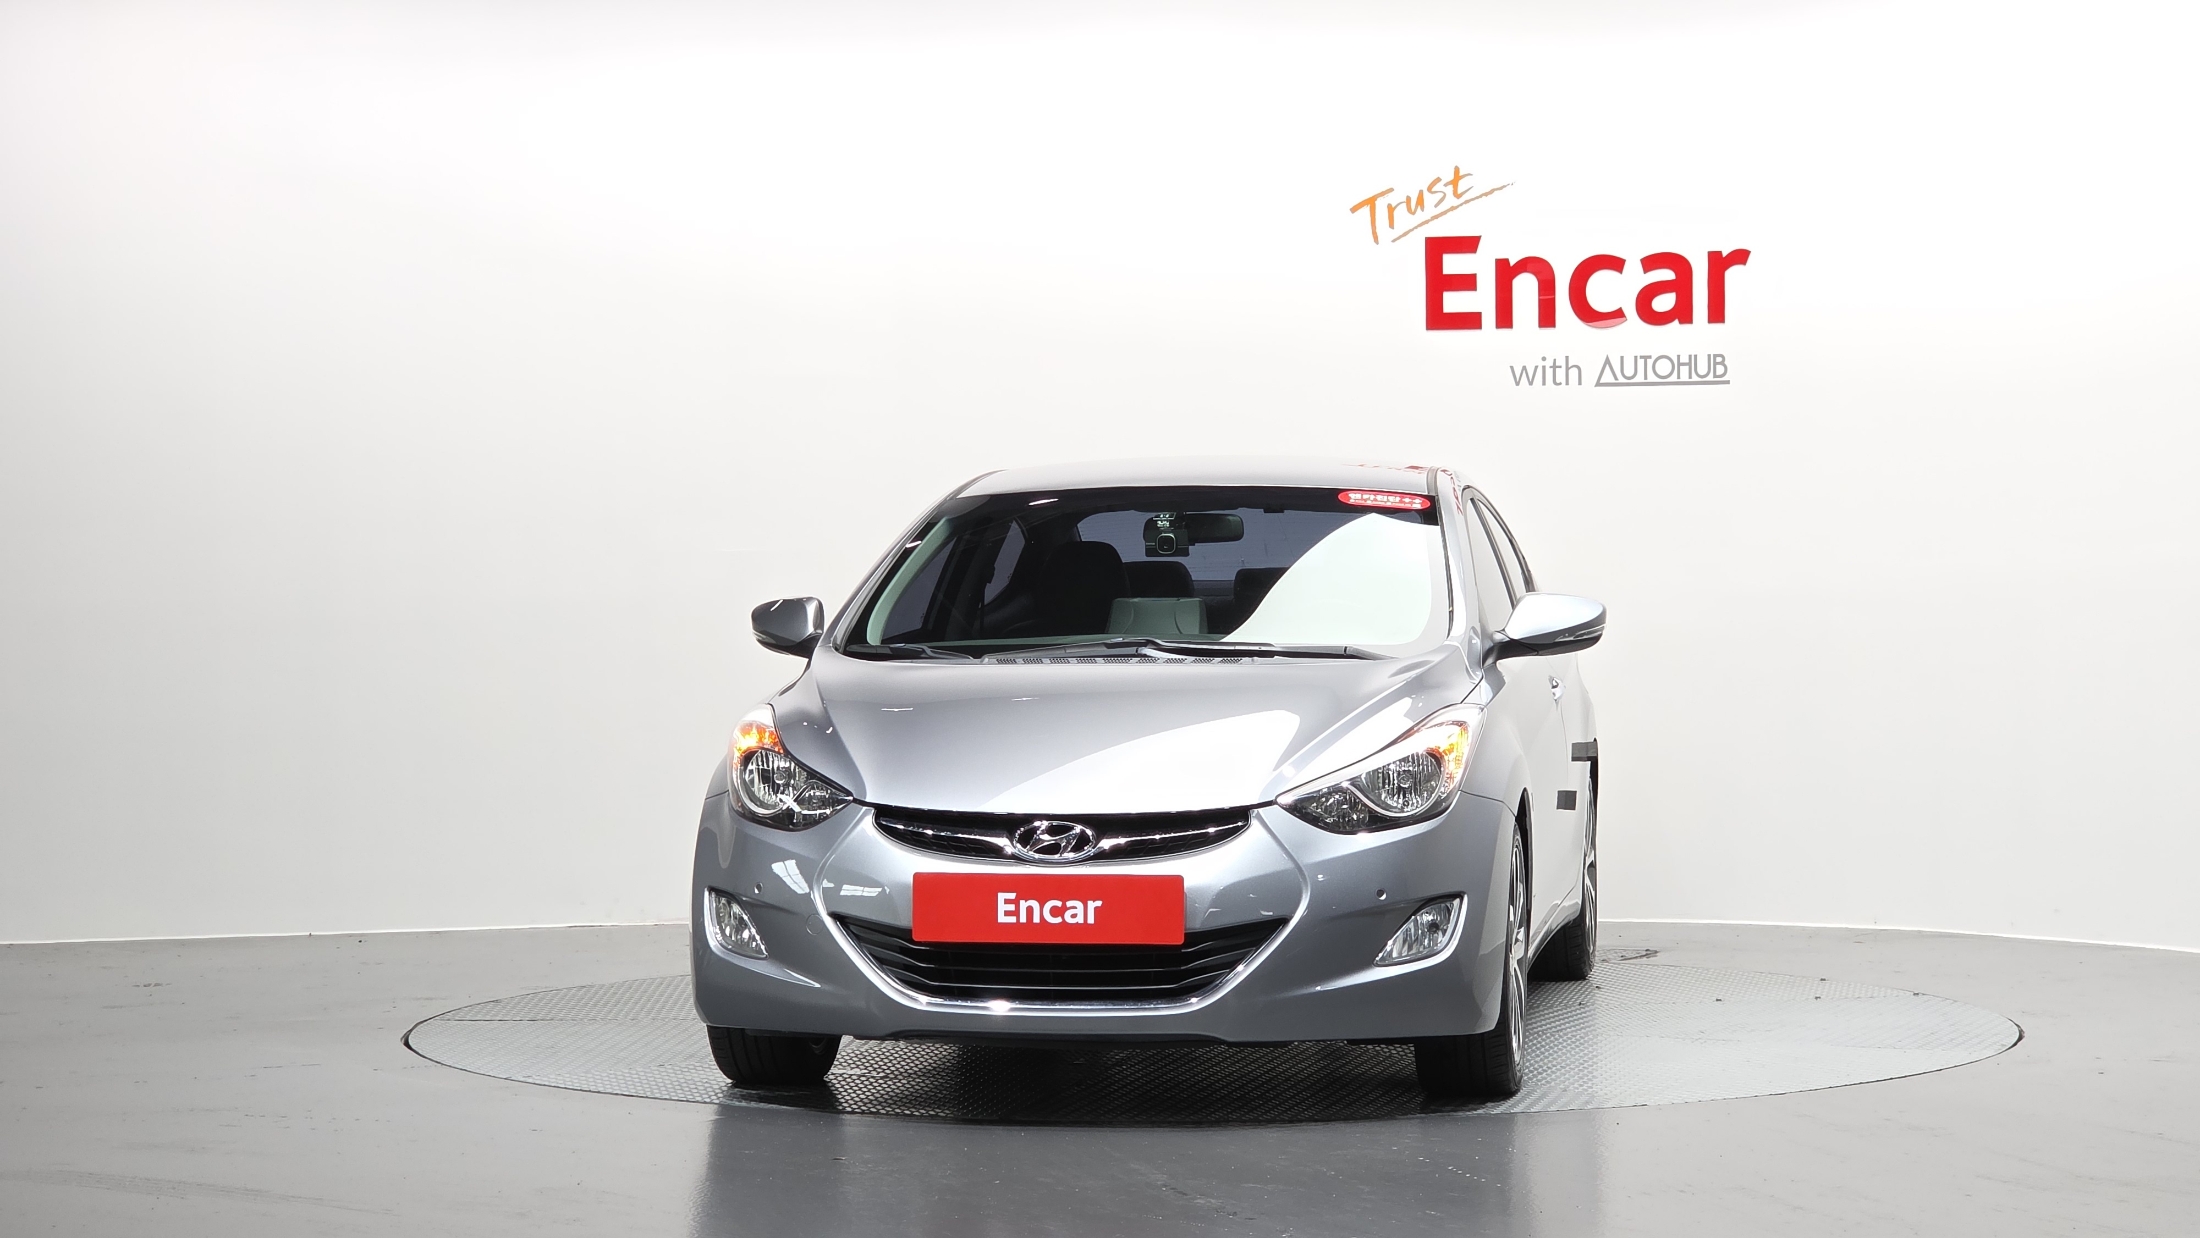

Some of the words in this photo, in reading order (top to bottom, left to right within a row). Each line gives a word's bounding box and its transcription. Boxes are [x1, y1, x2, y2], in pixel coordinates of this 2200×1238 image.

[1350, 165, 1474, 245] Trust
[1425, 235, 1751, 331] Encar
[1510, 356, 1582, 387] with
[1594, 353, 1730, 387] AUTOHUB
[997, 892, 1103, 924] Encar
